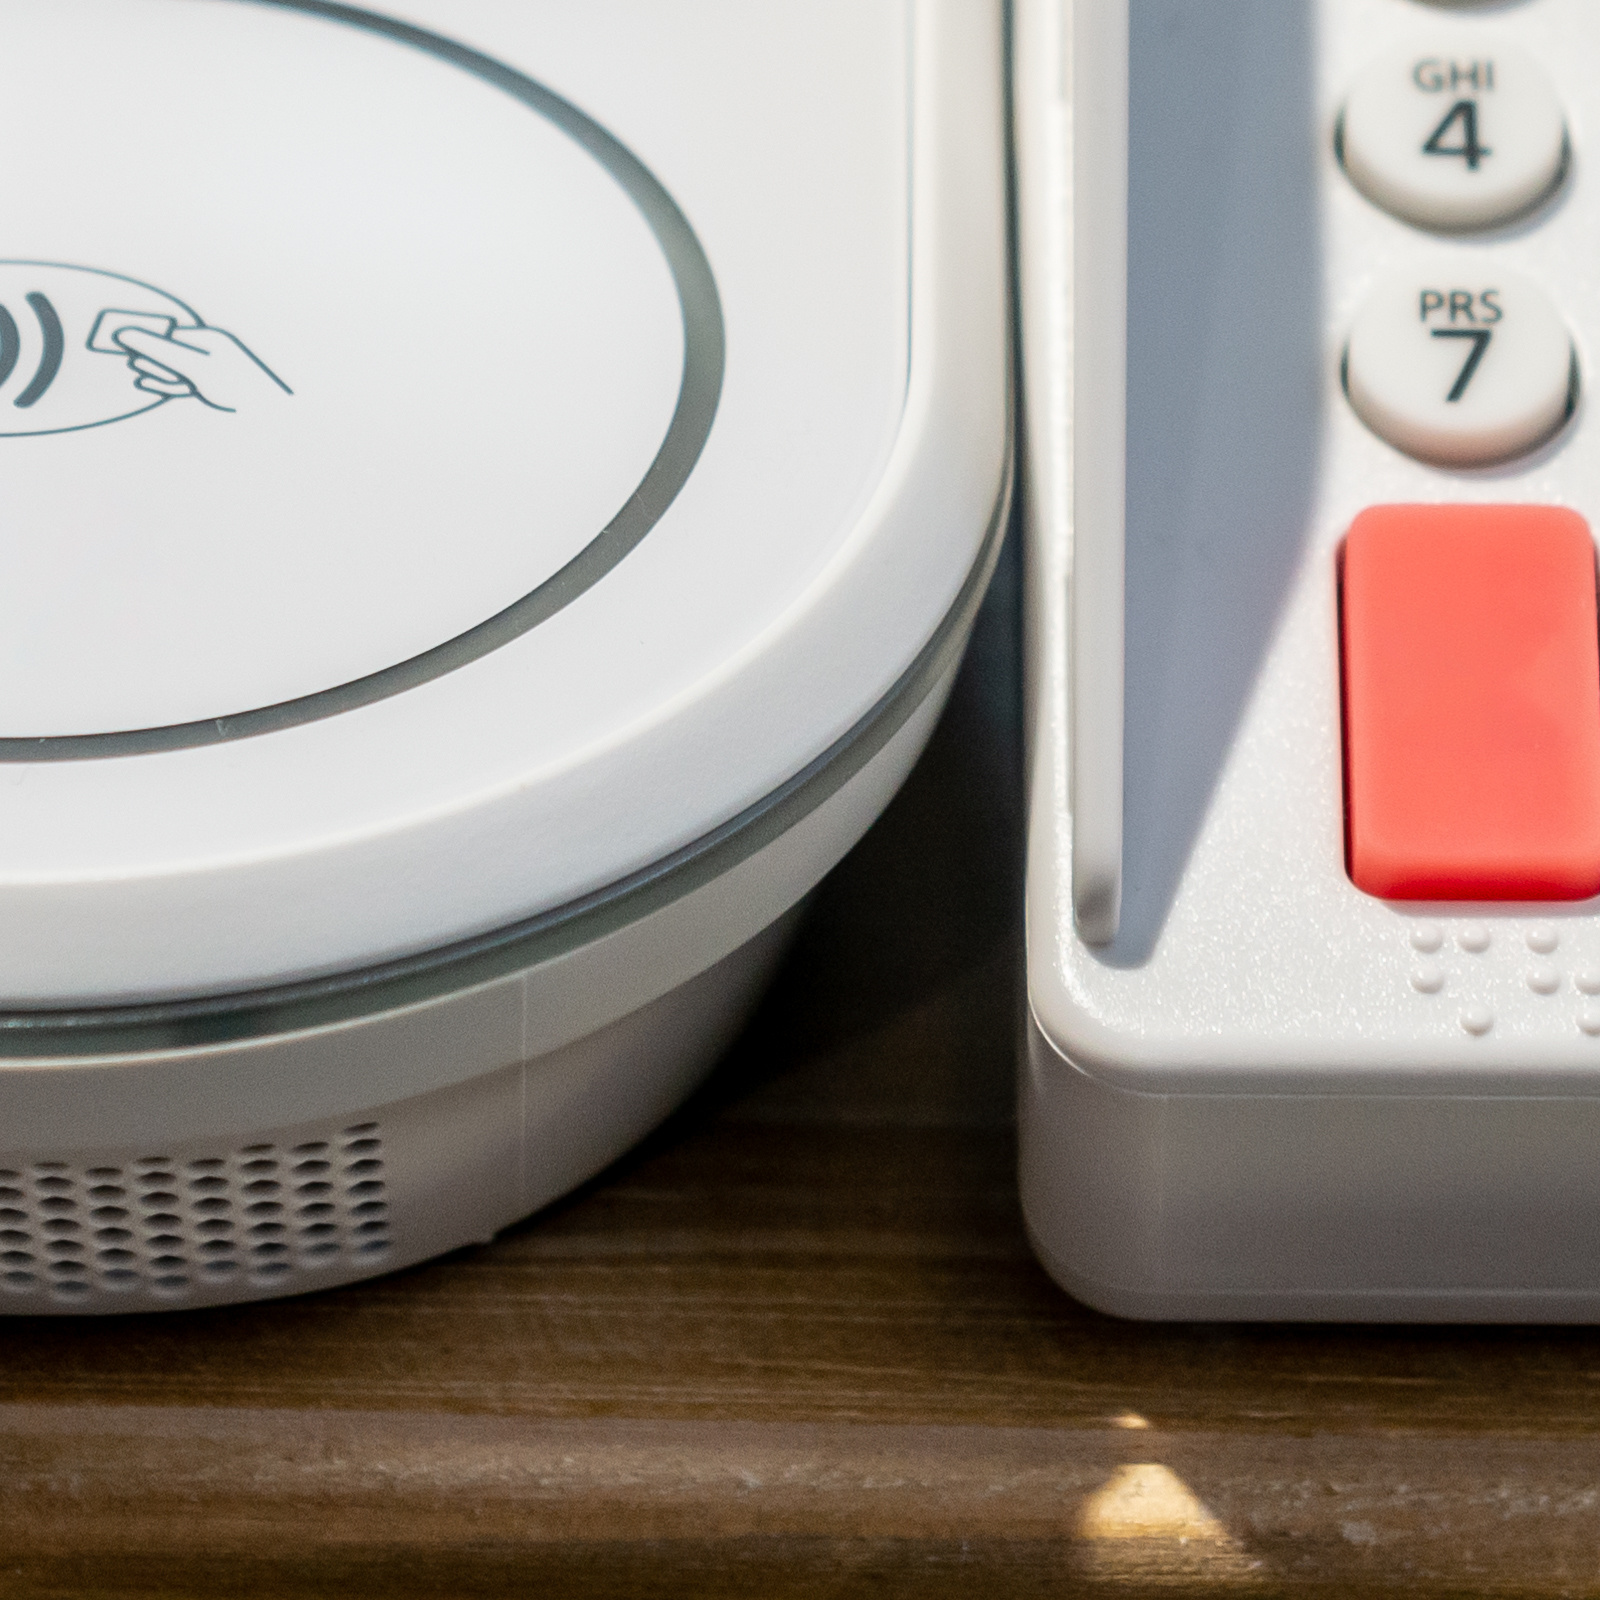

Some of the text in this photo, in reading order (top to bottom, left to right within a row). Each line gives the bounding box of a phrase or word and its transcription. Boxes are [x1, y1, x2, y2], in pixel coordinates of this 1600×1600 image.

[1412, 59, 1496, 97] GHI
[1421, 99, 1492, 172] 4
[1418, 289, 1504, 325] PRS
[1430, 327, 1494, 404] 7
